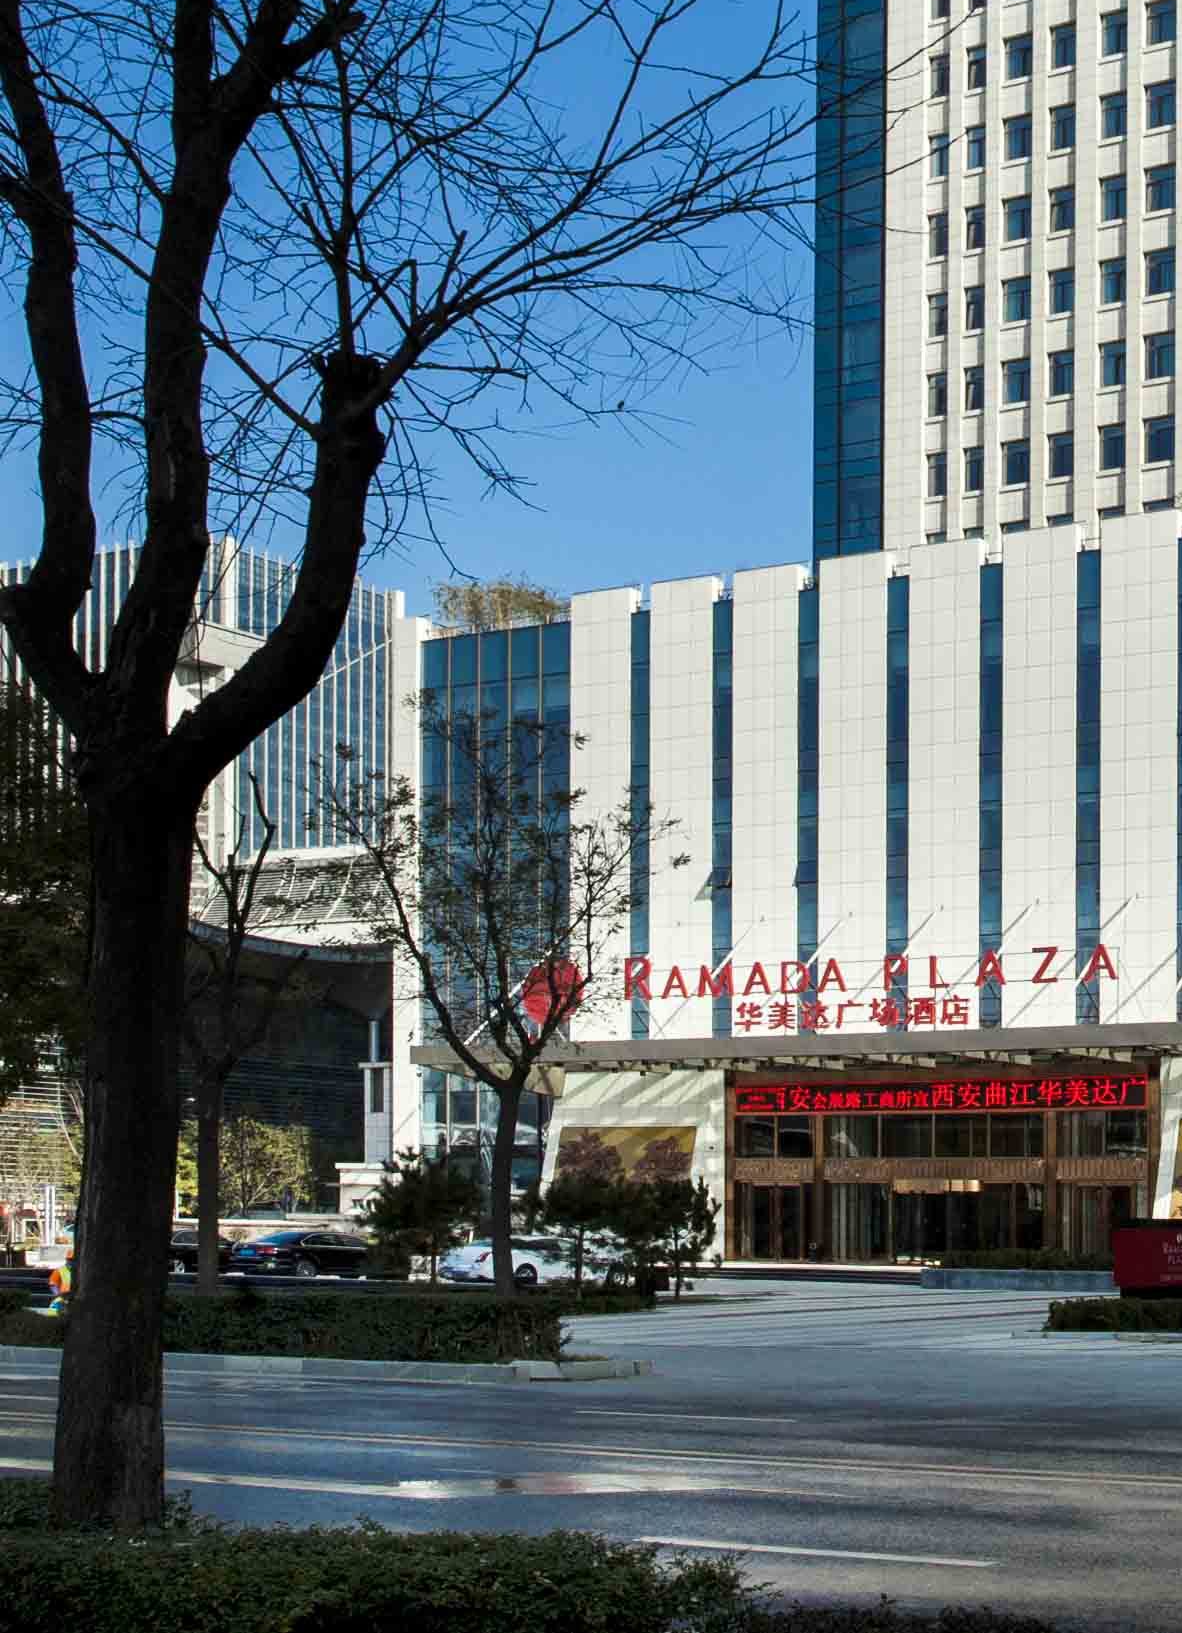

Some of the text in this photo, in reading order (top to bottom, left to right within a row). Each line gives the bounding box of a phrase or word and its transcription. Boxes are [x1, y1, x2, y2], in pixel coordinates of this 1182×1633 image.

[624, 944, 1118, 1001] RAMADA PLAZA
[735, 994, 970, 1032] 华美达广场酒店
